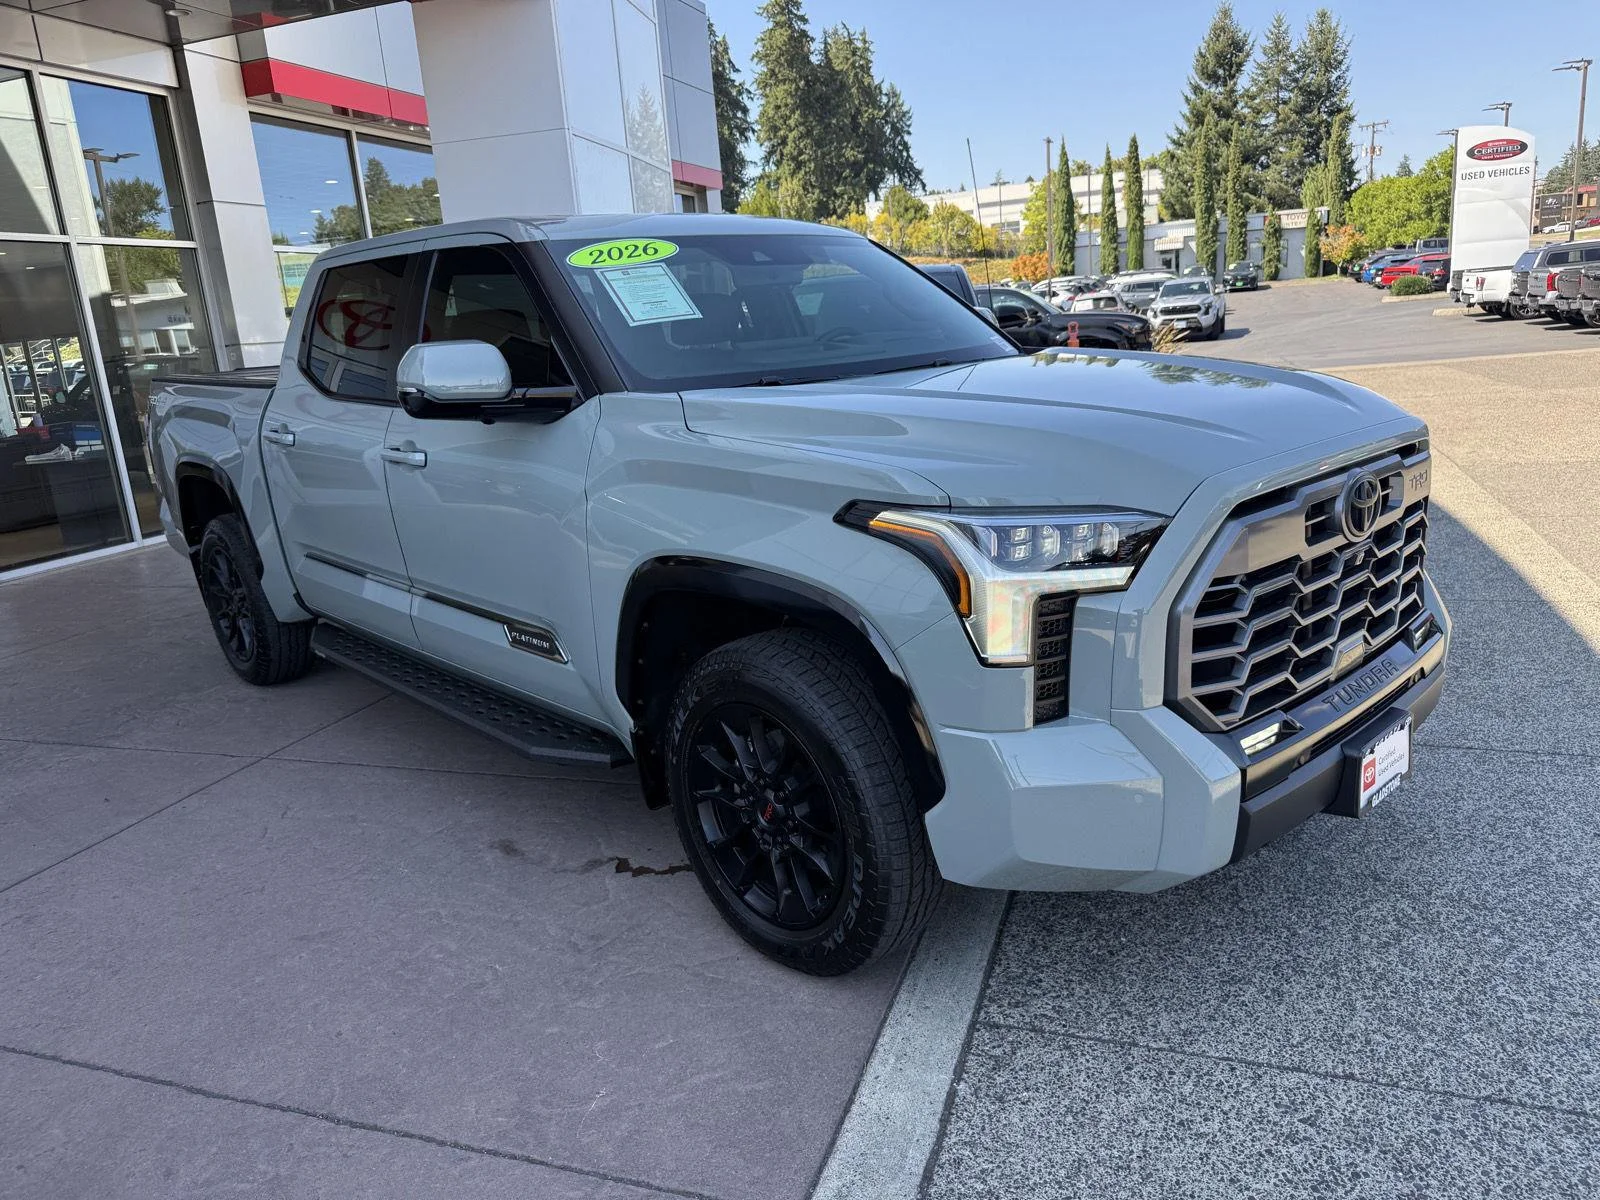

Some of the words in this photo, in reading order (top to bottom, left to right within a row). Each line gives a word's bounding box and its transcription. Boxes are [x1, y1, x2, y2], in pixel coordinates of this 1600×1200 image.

[1474, 145, 1521, 156] CERTIFIED
[1461, 171, 1485, 181] USED
[1487, 166, 1530, 178] VEHICLES
[1286, 213, 1307, 221] TOYO
[589, 242, 659, 264] 2026
[1409, 469, 1428, 491] TRD
[511, 631, 550, 649] PLATINUM
[1321, 659, 1399, 712] TUNDRA
[1379, 745, 1396, 765] Certified
